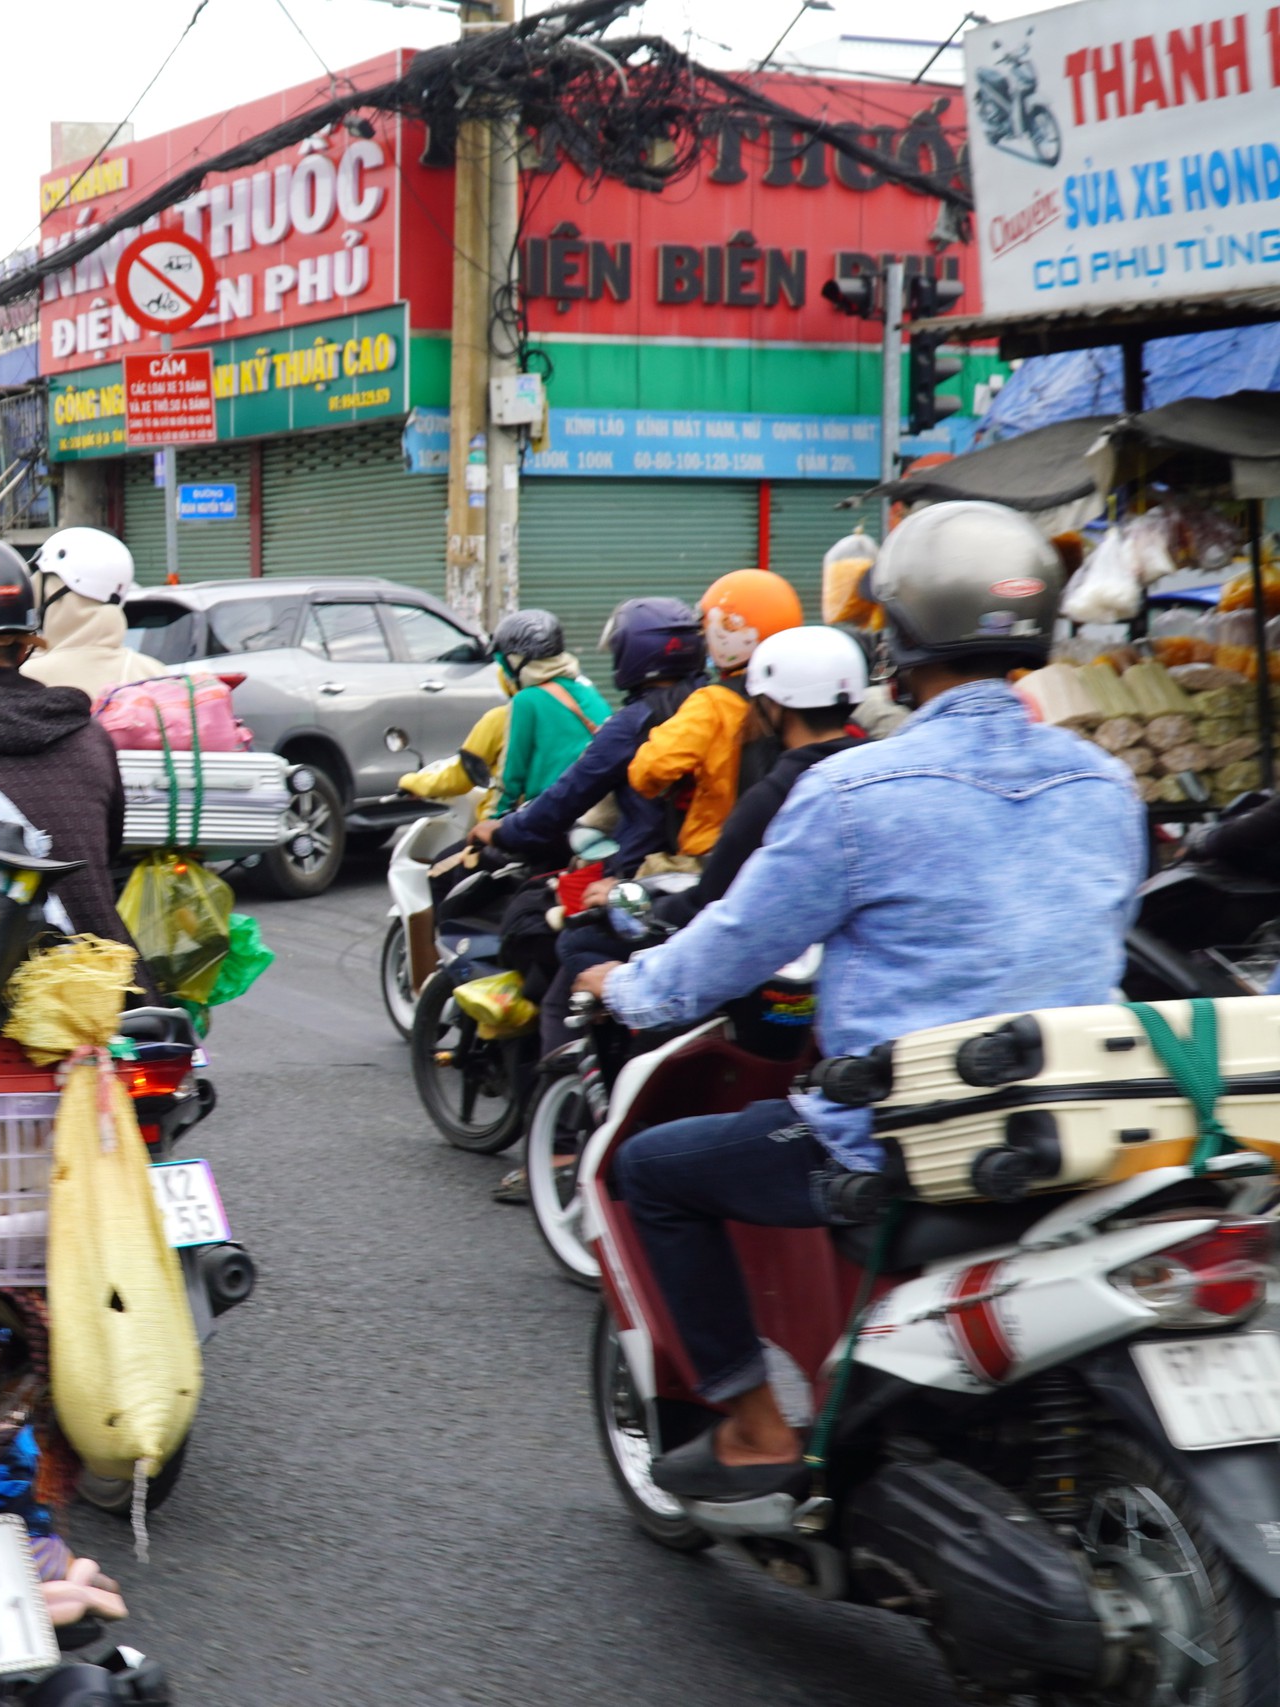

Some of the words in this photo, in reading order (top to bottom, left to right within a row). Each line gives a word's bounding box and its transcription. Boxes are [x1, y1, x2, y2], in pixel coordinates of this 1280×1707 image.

[1064, 13, 1252, 126] THANH
[173, 123, 385, 259] THUỐC
[1063, 157, 1125, 230] SỬA
[1131, 160, 1173, 219] XE
[263, 229, 370, 312] PHỦ
[525, 222, 631, 314] IỆN
[657, 230, 807, 308] BIÊN
[1033, 244, 1081, 290] CÓ
[1090, 243, 1167, 288] PHỤ
[51, 297, 141, 359] ĐIỆN
[272, 337, 342, 392] THUẬT
[343, 333, 396, 377] CAO
[149, 353, 187, 377] CẤM
